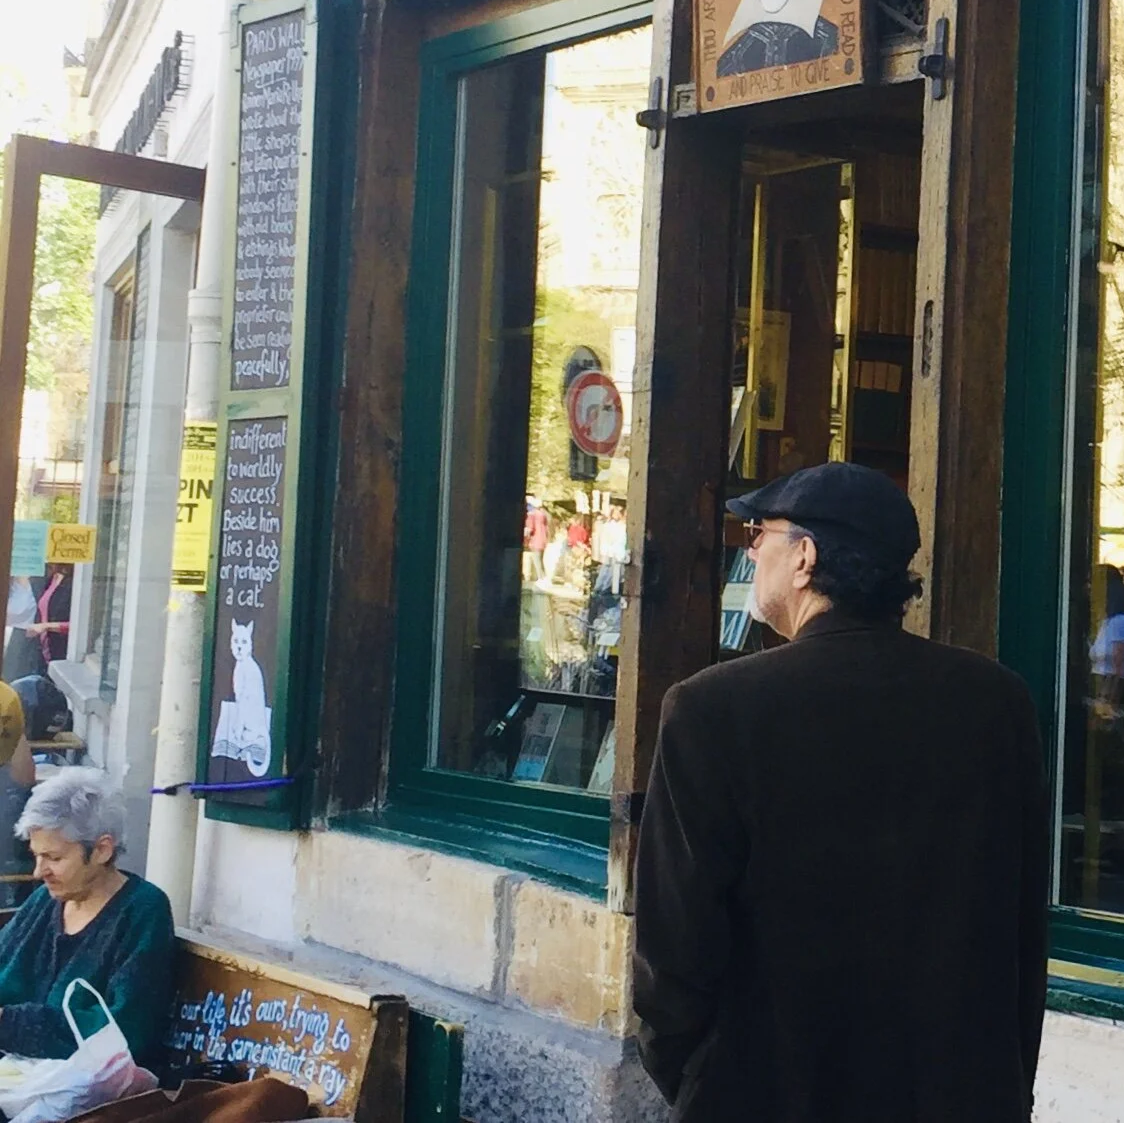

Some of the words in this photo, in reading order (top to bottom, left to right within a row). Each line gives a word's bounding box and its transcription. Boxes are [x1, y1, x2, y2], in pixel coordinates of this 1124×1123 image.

[245, 28, 276, 57] PARIS
[703, 30, 716, 62] THOU
[839, 12, 855, 57] READ
[729, 76, 747, 100] AND
[749, 68, 784, 94] PRAISE
[790, 65, 800, 88] TO
[806, 59, 830, 84] GIVE
[230, 422, 286, 455] indifferent
[227, 457, 237, 480] to
[237, 455, 282, 485] worldly
[222, 508, 257, 531] Beside
[259, 507, 279, 533] him
[222, 536, 242, 558] lies
[245, 536, 254, 558] a
[256, 536, 280, 572] dog
[220, 564, 232, 580] or
[233, 558, 272, 588] perhaps
[226, 587, 233, 606] a
[237, 585, 264, 608] cat.
[181, 1003, 201, 1021] our
[230, 989, 252, 1026] it's
[256, 1000, 287, 1030] ours,
[290, 994, 329, 1055] trying
[332, 1019, 350, 1052] to
[193, 1026, 205, 1051] in
[207, 1025, 227, 1061] the
[228, 1038, 261, 1063] same
[262, 1037, 306, 1078] instant
[305, 1059, 315, 1082] a
[319, 1064, 346, 1106] ray
